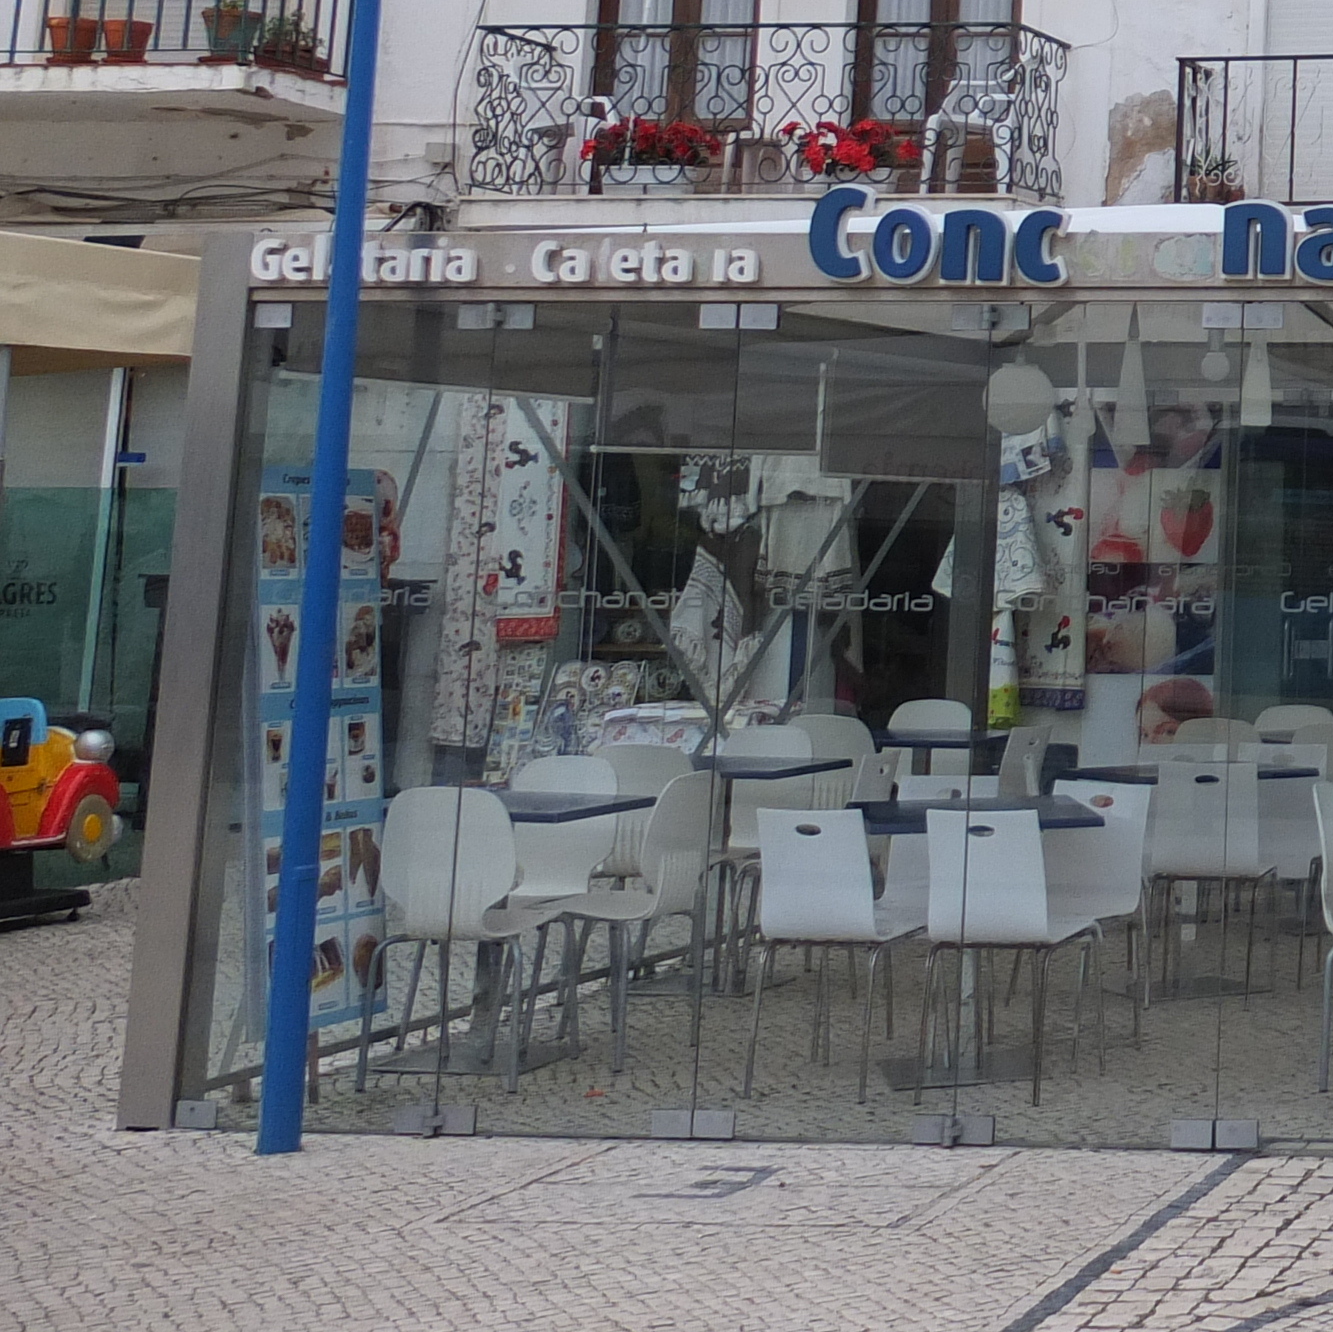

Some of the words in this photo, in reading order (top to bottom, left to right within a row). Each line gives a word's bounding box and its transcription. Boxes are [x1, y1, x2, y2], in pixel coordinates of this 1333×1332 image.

[250, 235, 480, 284] Geltaria
[530, 239, 762, 285] Caetaia
[0, 582, 58, 605] GRES
[769, 587, 935, 612] Geladaria
